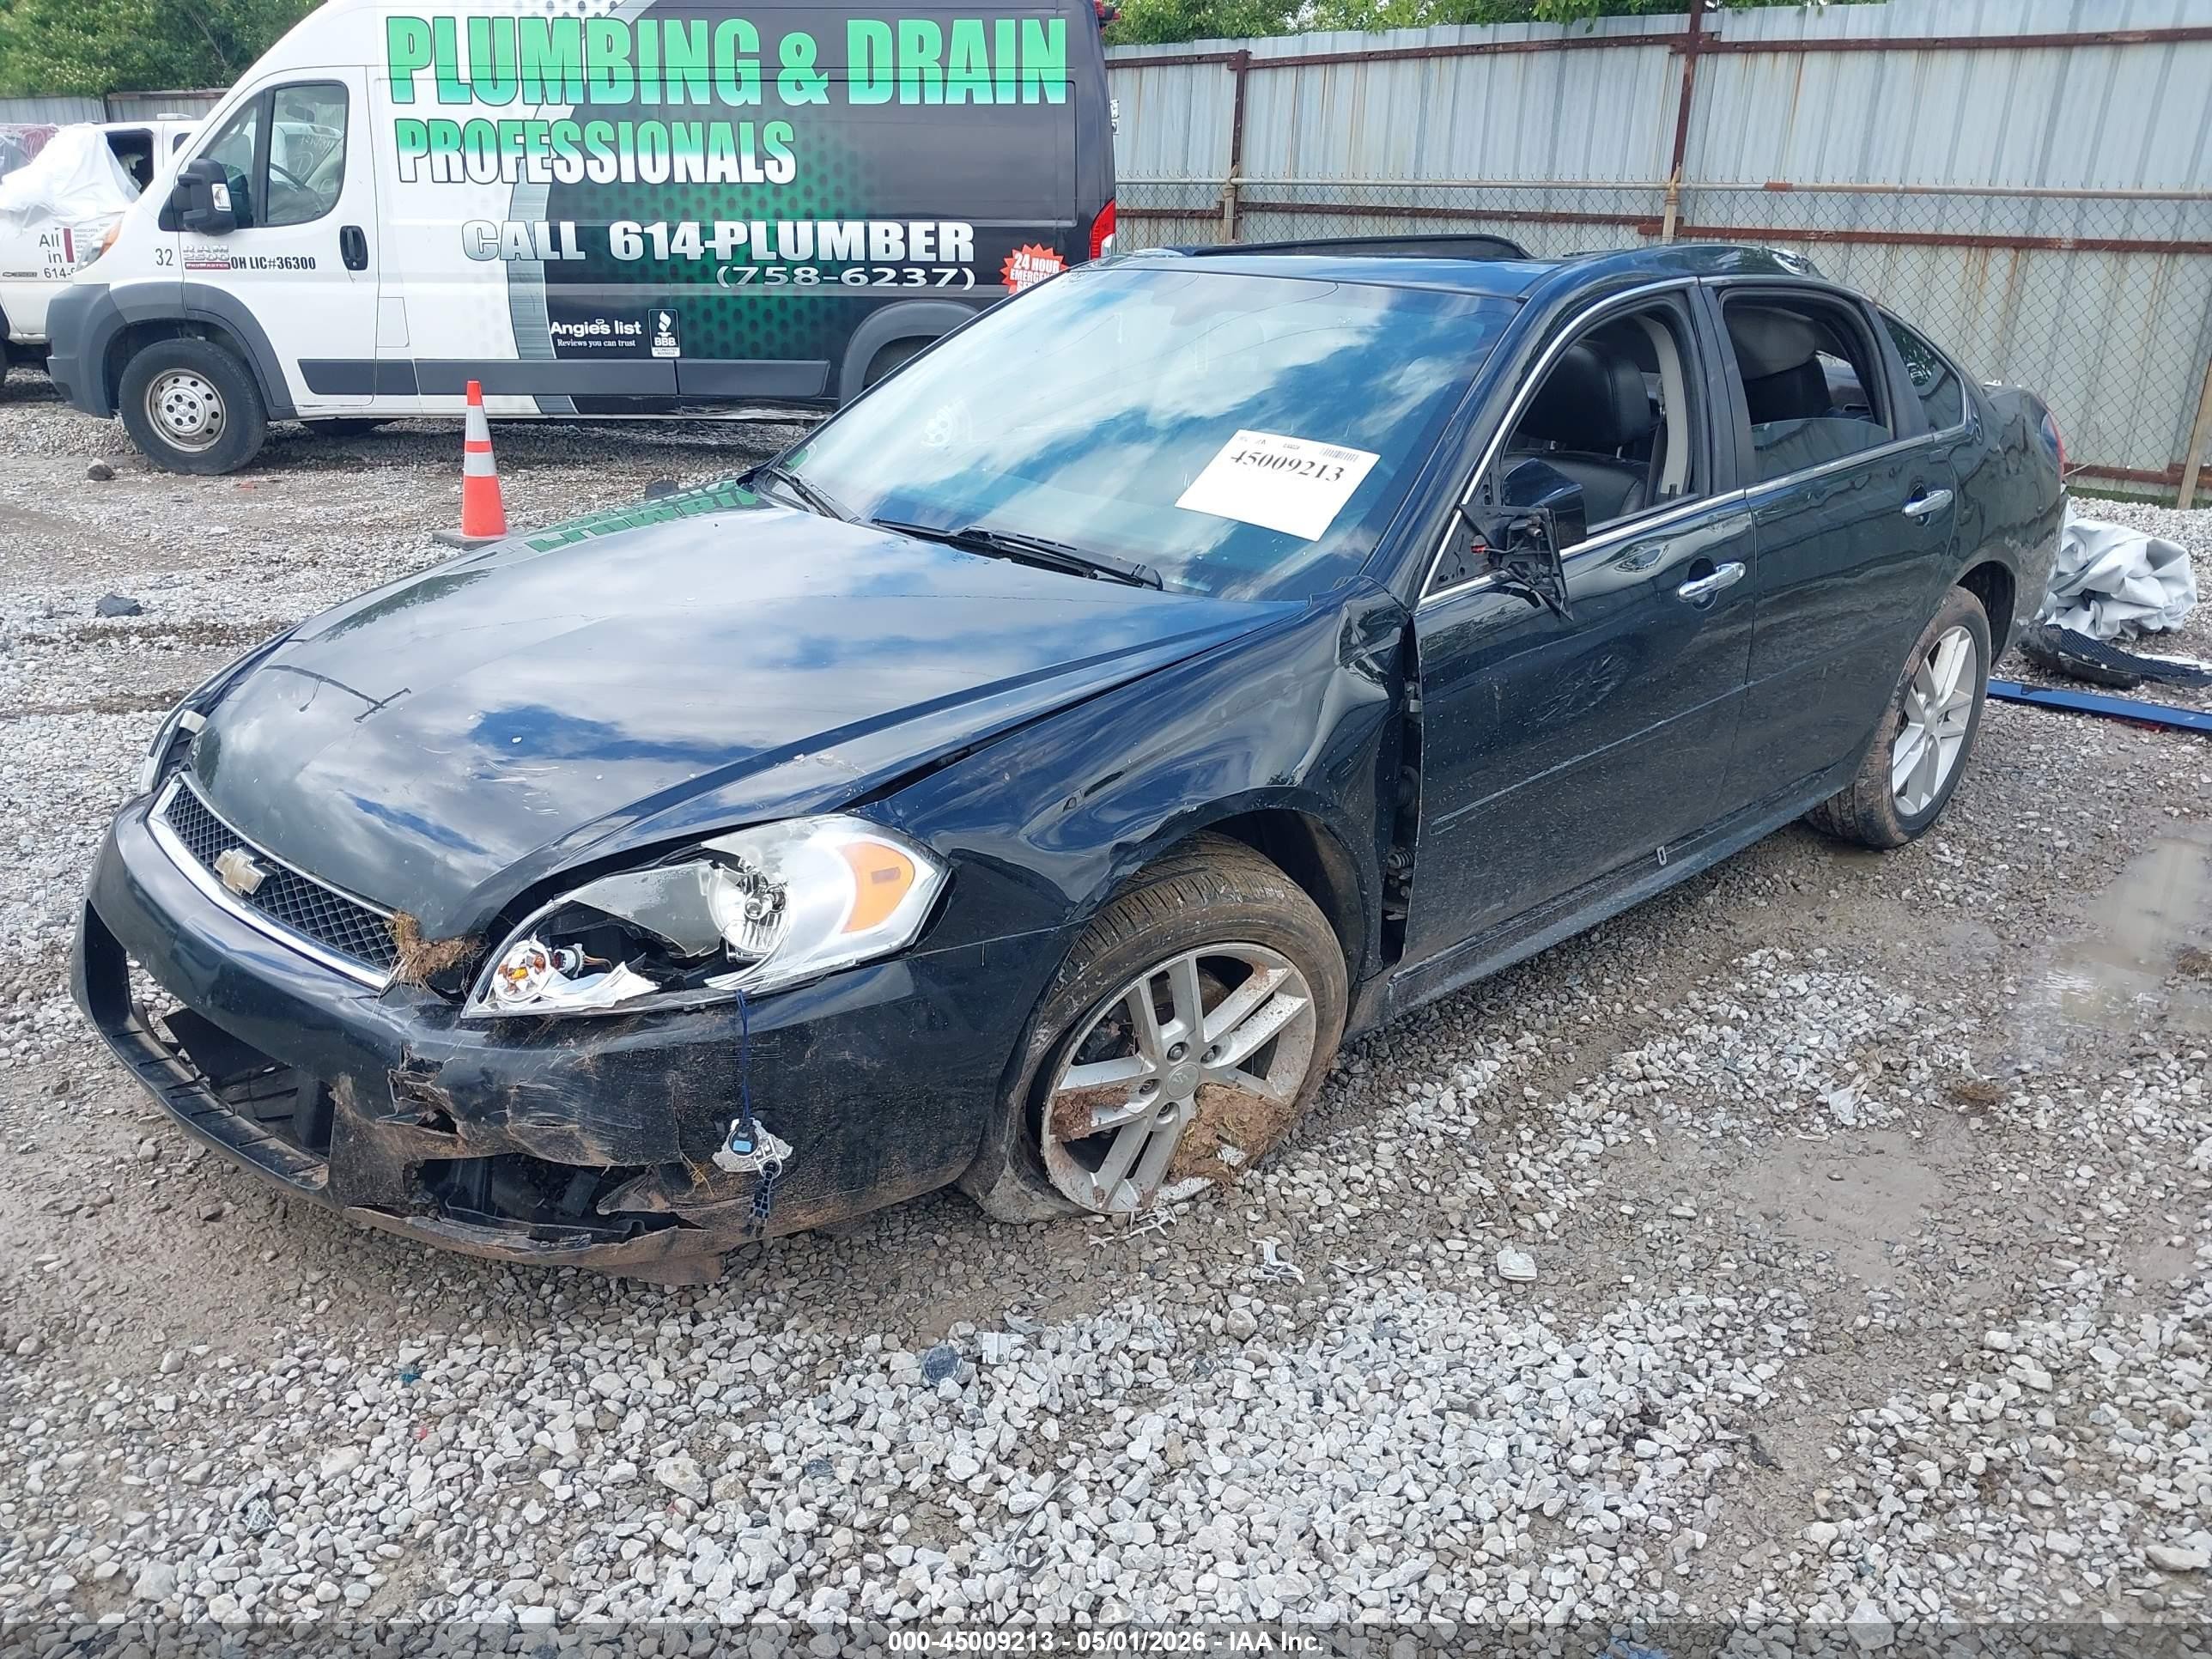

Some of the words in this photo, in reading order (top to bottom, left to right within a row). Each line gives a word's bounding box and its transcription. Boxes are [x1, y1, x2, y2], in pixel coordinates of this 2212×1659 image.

[386, 15, 762, 106] PLUMBING
[777, 32, 830, 106] &
[847, 19, 1066, 105] DRAIN
[395, 118, 797, 185] PROFESSIONALS
[39, 234, 59, 247] All
[183, 244, 229, 252] RAM
[462, 220, 586, 261] CALL
[609, 220, 975, 262] 614-PLUMBER
[48, 251, 63, 263] in
[155, 248, 173, 266] 32
[231, 257, 246, 270] OH
[250, 257, 316, 270] LIC#36300
[1013, 252, 1030, 270] 24
[1031, 258, 1060, 274] HOUR
[716, 265, 975, 290] (758-6237)
[614, 320, 641, 335] list
[557, 338, 586, 348] Reviews
[588, 340, 601, 349] you
[617, 339, 636, 348] trust
[654, 337, 676, 347] BBB
[1231, 450, 1345, 482] 45009213
